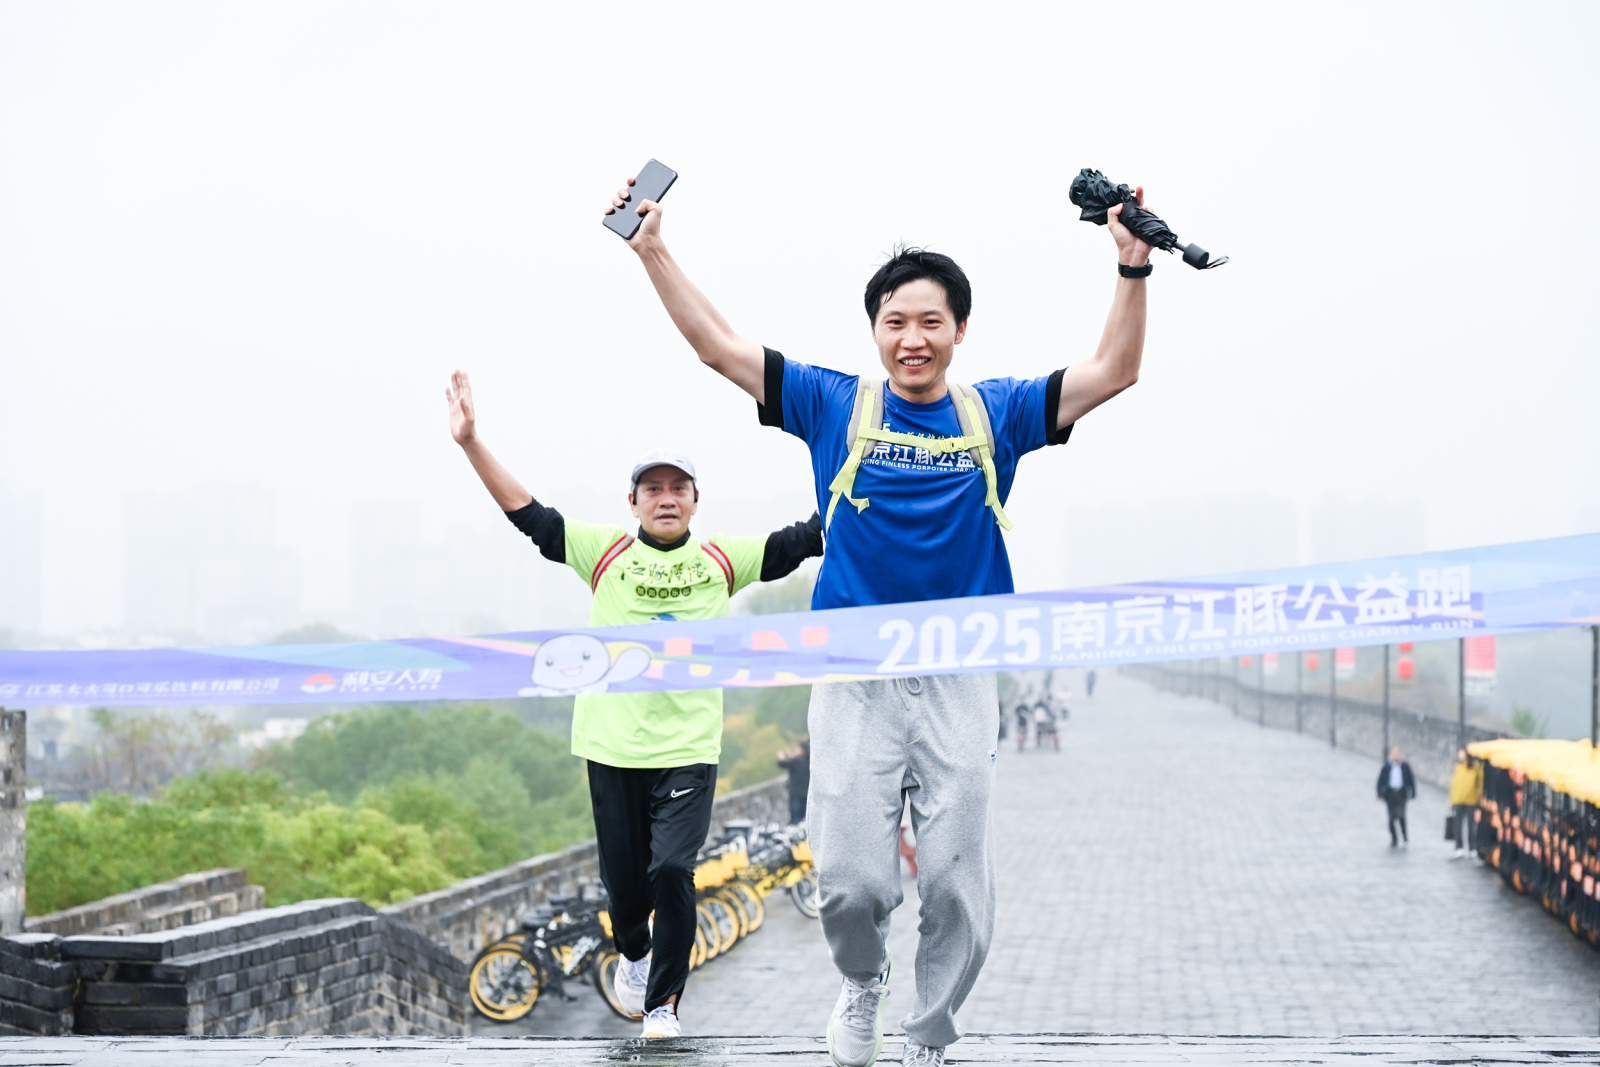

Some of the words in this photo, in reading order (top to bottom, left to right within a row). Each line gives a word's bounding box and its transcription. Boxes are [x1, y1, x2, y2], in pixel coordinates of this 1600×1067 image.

[881, 460, 910, 470] FINLESS
[911, 464, 948, 472] PORPOISE
[1049, 564, 1472, 651] 南京江豚公益跑
[1050, 646, 1138, 662] NANJING
[1144, 640, 1225, 656] FINLESS
[1231, 632, 1332, 649] PORPOISE
[1338, 623, 1424, 641] CHARITY
[1431, 618, 1475, 632] RUN
